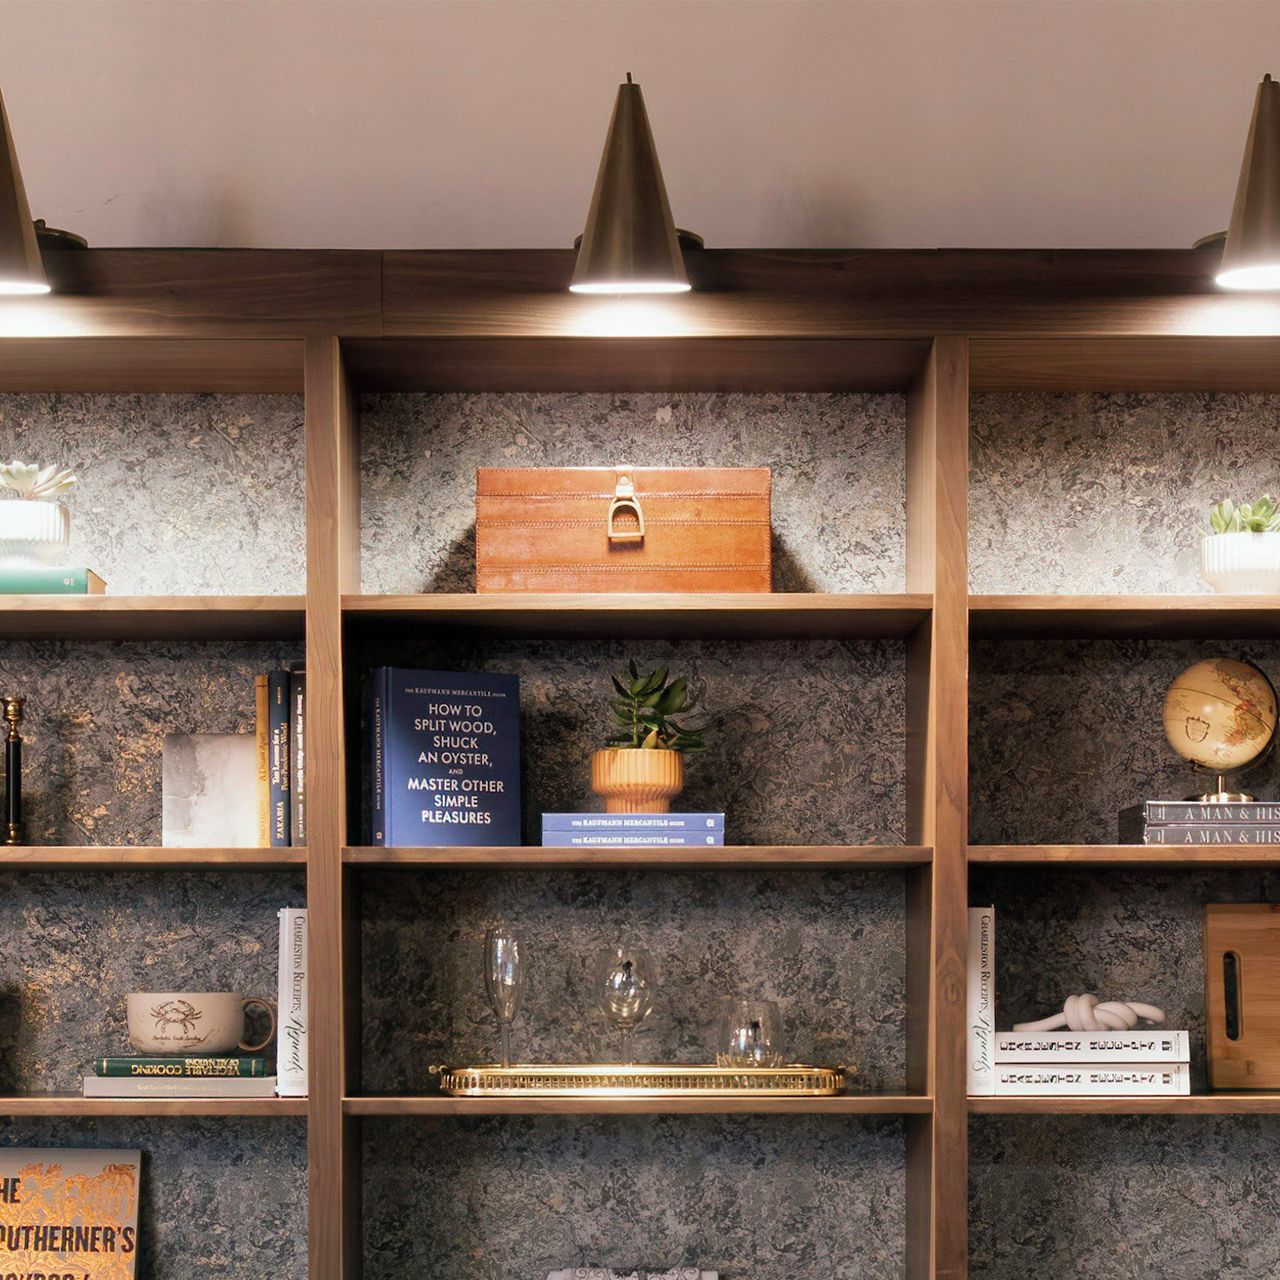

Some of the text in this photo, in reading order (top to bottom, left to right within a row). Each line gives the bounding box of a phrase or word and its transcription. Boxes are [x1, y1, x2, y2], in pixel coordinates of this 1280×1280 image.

[429, 703, 482, 717] HOW TO
[414, 718, 497, 735] SPLIT WOOD,
[433, 735, 478, 749] SHUCK
[418, 752, 493, 767] AN OYSTER,
[407, 778, 504, 792] MASTER OTHER
[434, 795, 478, 807] SIMPLE
[276, 801, 284, 839] ZAKARIA
[421, 810, 491, 824] PLEASURES
[1185, 808, 1194, 819] A
[1200, 808, 1233, 820] MAN
[1239, 808, 1250, 820] &
[1184, 831, 1193, 843] A
[1200, 831, 1232, 843] MAN
[1239, 831, 1249, 843] &
[293, 915, 306, 969] CHARLESTON
[980, 915, 991, 970] CHARLESTON
[1000, 1041, 1081, 1051] CHARLESTON
[131, 1064, 240, 1076] VEGETABLE COOKING
[1001, 1074, 1081, 1084] CHARLESTON
